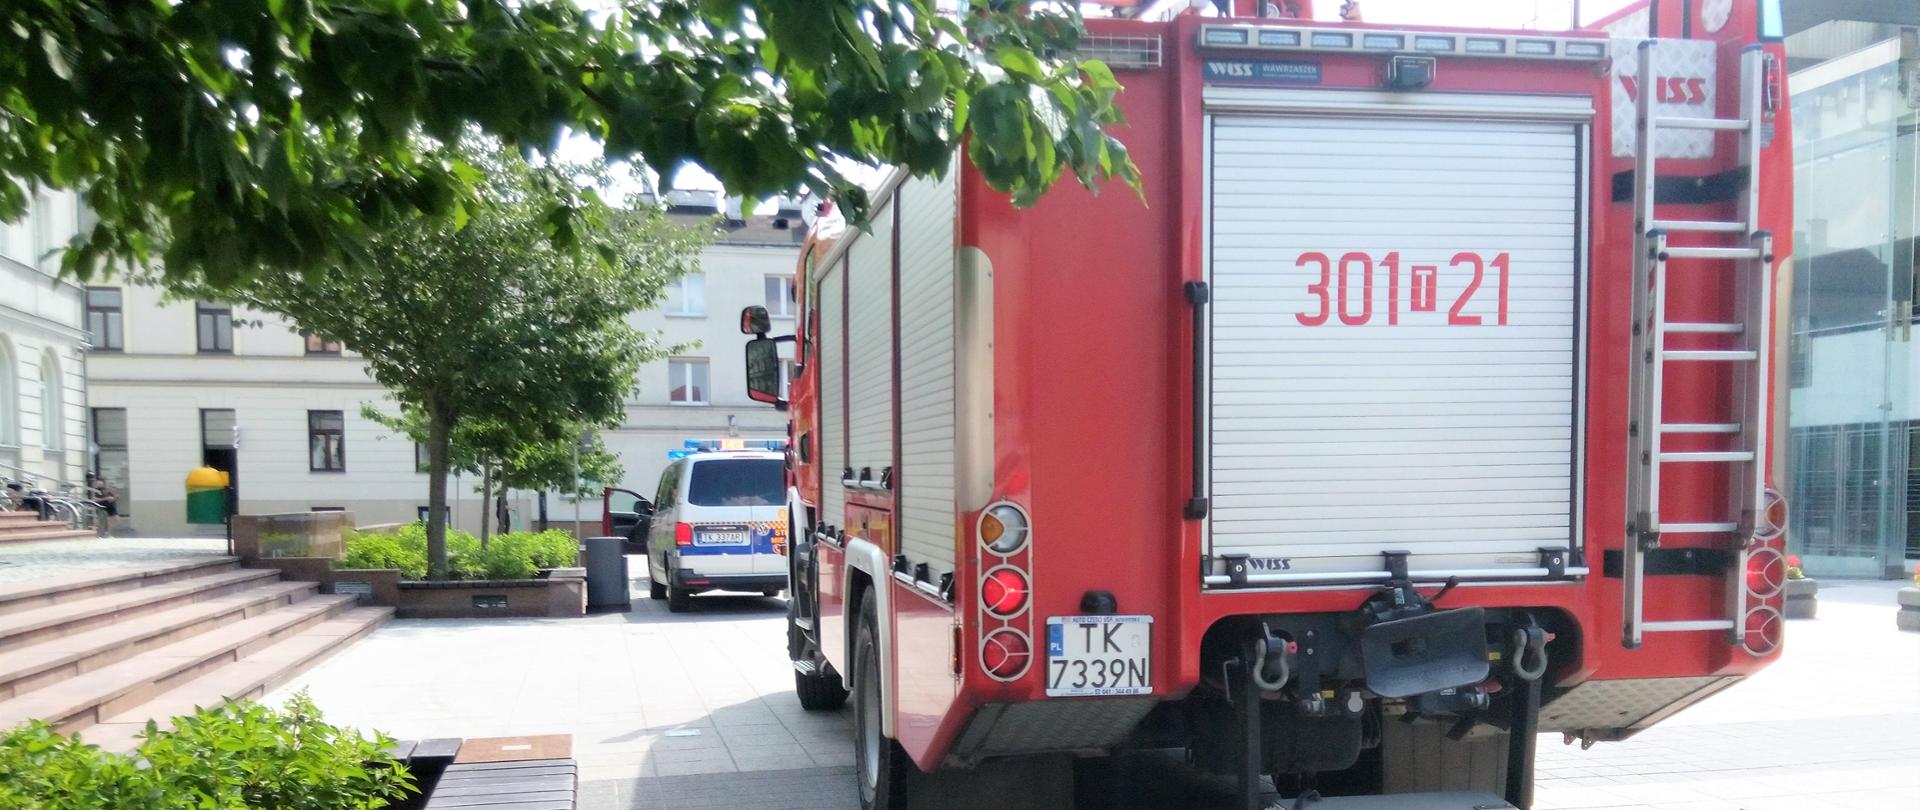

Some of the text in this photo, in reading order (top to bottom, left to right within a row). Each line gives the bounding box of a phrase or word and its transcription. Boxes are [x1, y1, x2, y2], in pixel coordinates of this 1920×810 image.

[1208, 62, 1252, 76] WISS
[1295, 251, 1399, 326] 301
[1448, 252, 1510, 326] 21
[1247, 558, 1292, 570] WISS
[1050, 642, 1062, 651] PL
[1079, 623, 1123, 653] TK
[1052, 657, 1146, 689] 7339N
